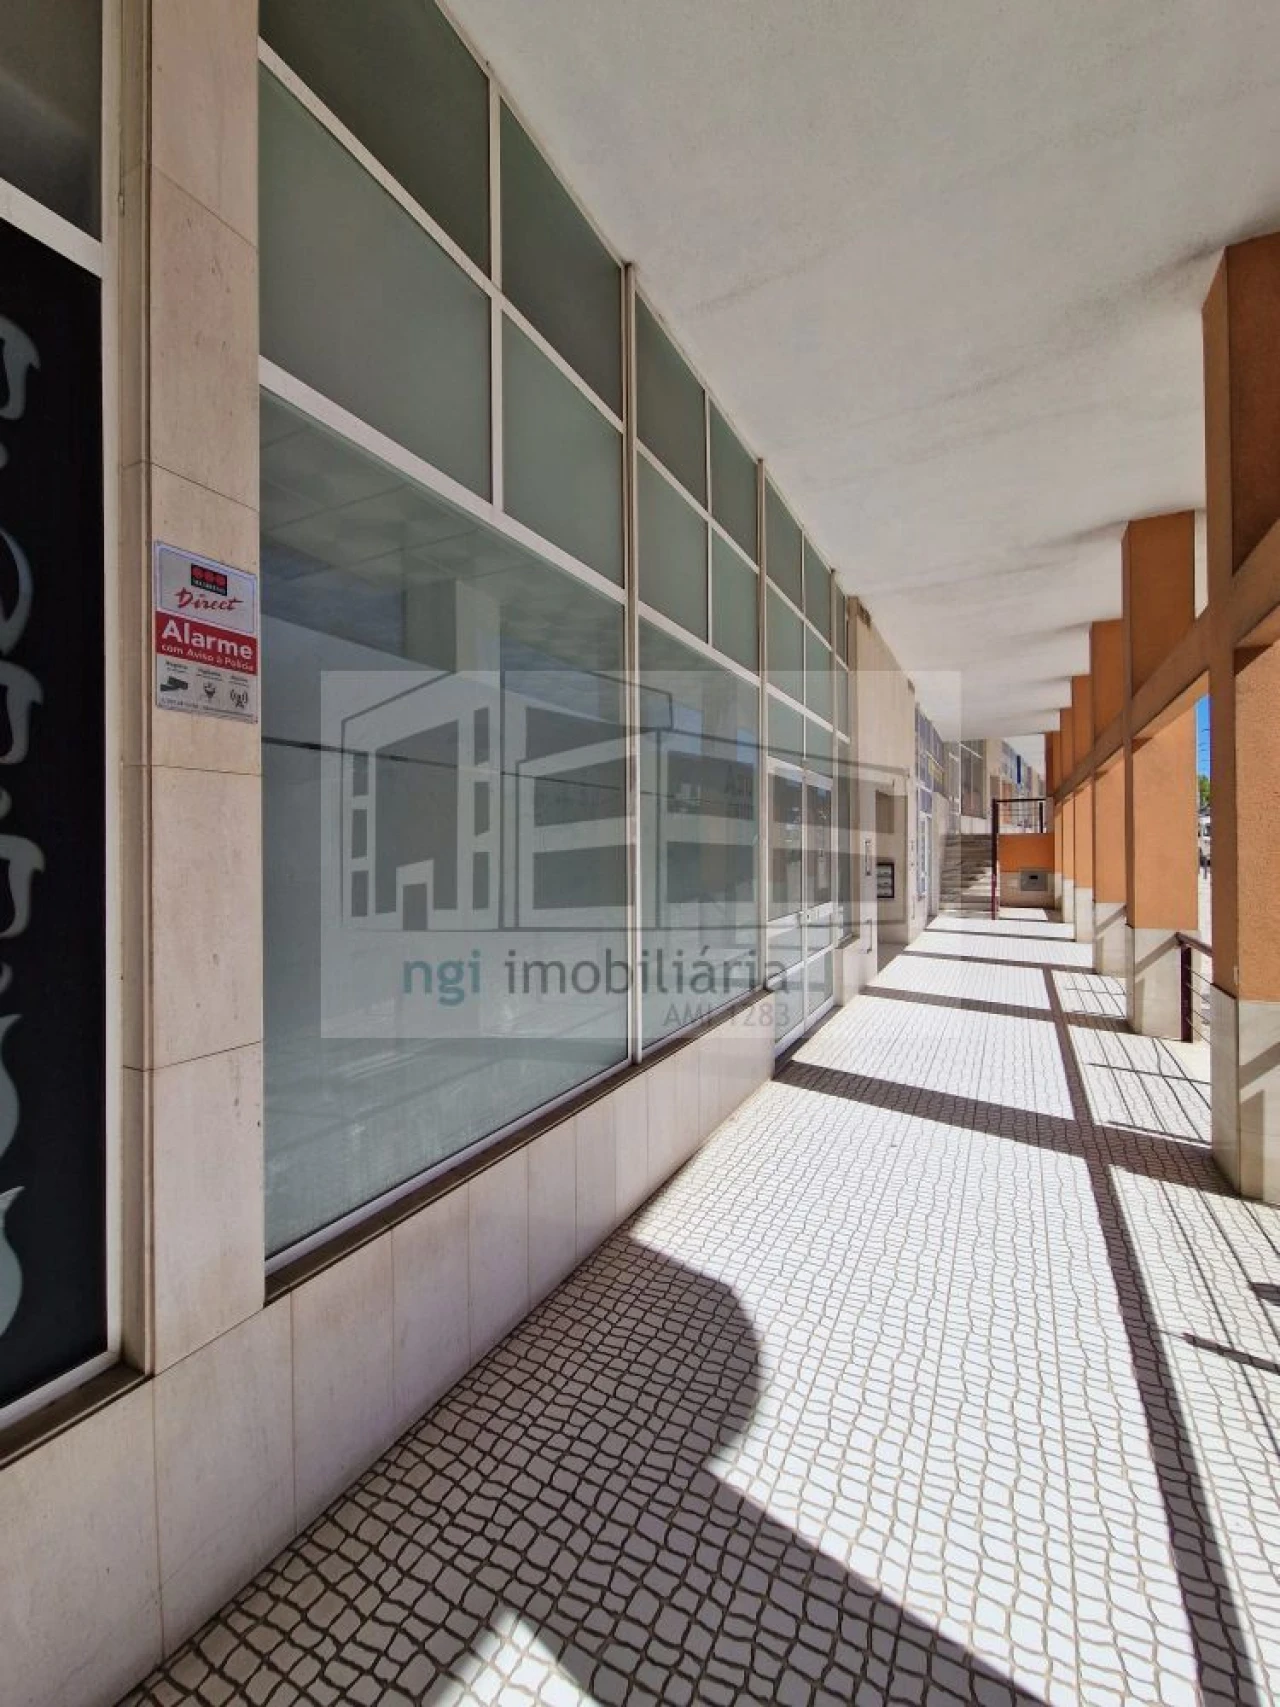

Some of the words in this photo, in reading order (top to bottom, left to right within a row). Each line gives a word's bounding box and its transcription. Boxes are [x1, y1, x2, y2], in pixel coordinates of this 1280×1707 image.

[174, 587, 244, 611] Direct
[161, 619, 254, 661] Alarme
[161, 644, 184, 655] com
[186, 648, 214, 661] Aviso
